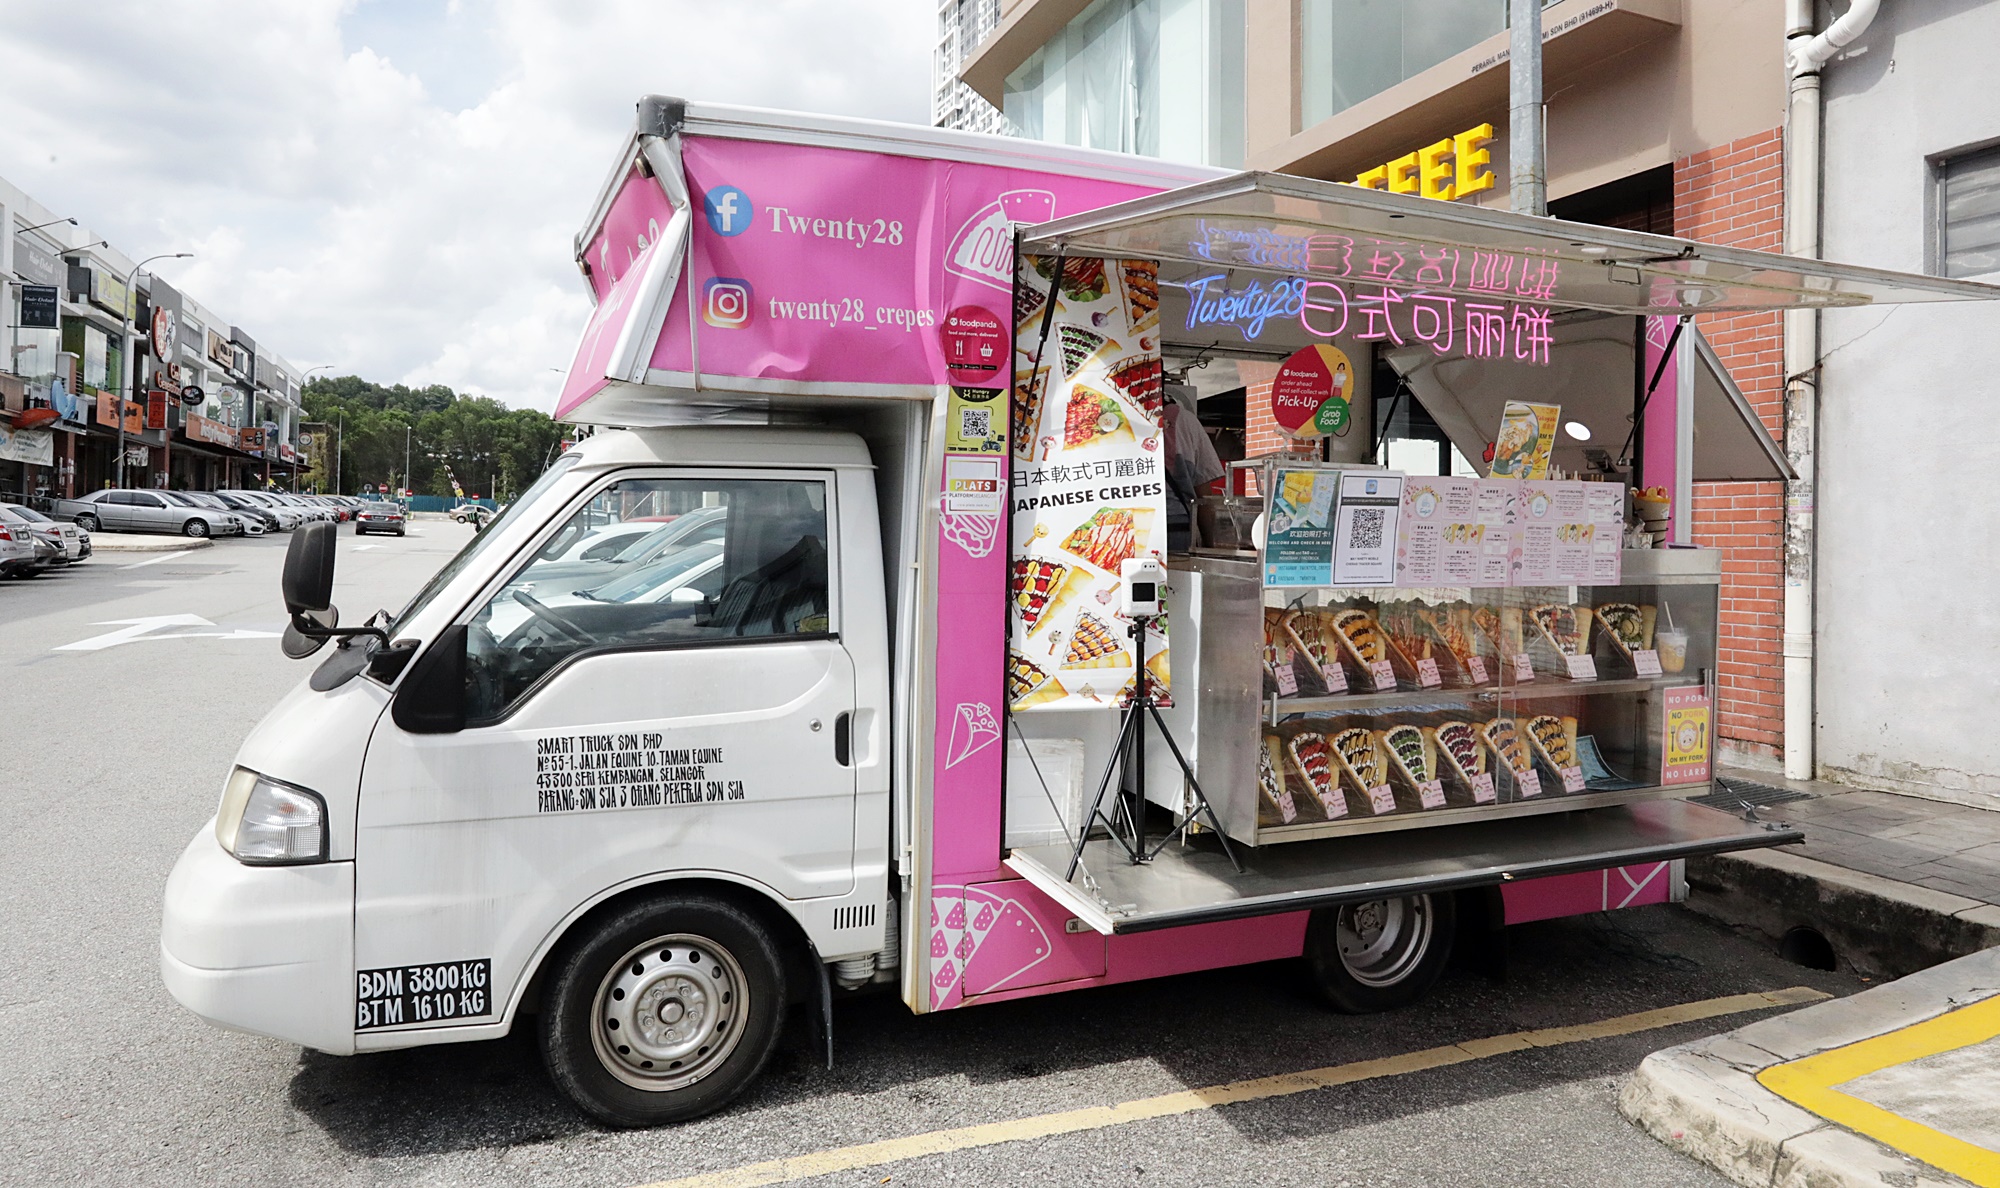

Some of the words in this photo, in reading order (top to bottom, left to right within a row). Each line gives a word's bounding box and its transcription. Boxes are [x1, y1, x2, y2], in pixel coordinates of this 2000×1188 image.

[765, 206, 904, 248] Twenty28
[769, 297, 935, 332] twenty28_crepes
[1189, 274, 1307, 339] Twenty28
[959, 318, 997, 329] foodpanda
[1301, 282, 1553, 364] 日式可丽饼
[1290, 370, 1319, 378] foodpanda
[1291, 387, 1317, 395] self-collect
[1277, 395, 1319, 411] Pick-Up
[1322, 410, 1341, 418] Grab
[1013, 456, 1156, 489] 日本軟式可麗餅
[955, 481, 991, 491] PLATS
[1099, 483, 1162, 500] CREPES
[1668, 696, 1681, 704] NO
[1671, 711, 1682, 719] NO
[537, 737, 575, 754] SMART
[579, 735, 614, 752] TRUCK
[618, 734, 638, 751] SDN
[643, 733, 662, 750] BHD
[579, 753, 608, 770] JALAN
[611, 751, 643, 768] EQUINE
[659, 749, 690, 766] TAMAN
[692, 748, 723, 764] EQUINE
[537, 772, 572, 789] 43300
[575, 771, 595, 787] SERI
[660, 766, 705, 782] SELANGOR
[1666, 770, 1679, 779] NO
[1684, 768, 1706, 776] LARD
[580, 787, 596, 811] SDN
[620, 786, 627, 808] 3
[631, 784, 661, 807] ORANG
[664, 782, 703, 805] PEKERJA
[706, 781, 724, 801] SDN
[358, 969, 403, 999] BDM
[408, 965, 459, 994] 3800
[461, 962, 487, 989] KG
[358, 997, 404, 1027] BTM
[411, 993, 455, 1021] 1610
[459, 989, 485, 1015] KG
